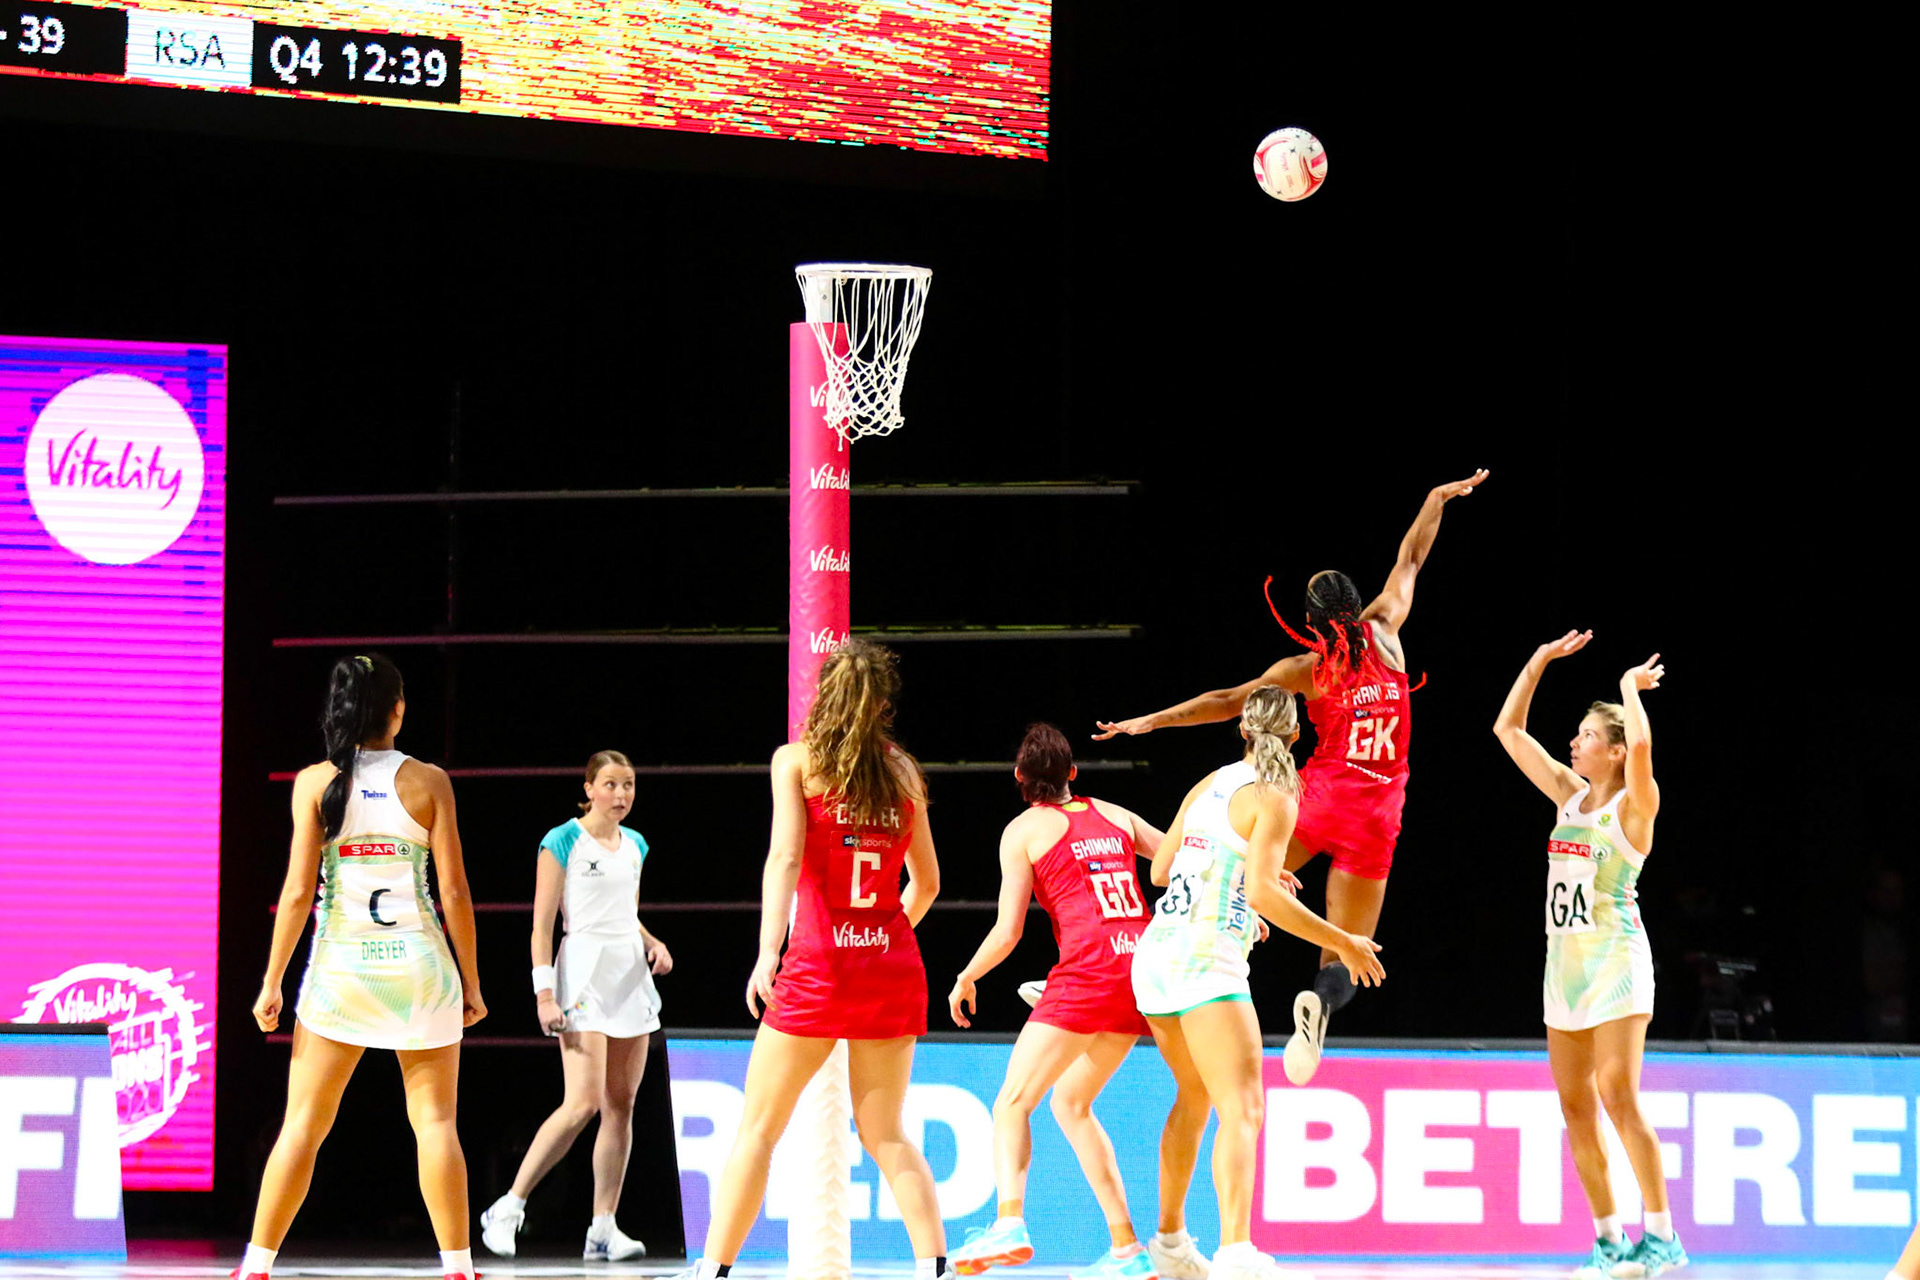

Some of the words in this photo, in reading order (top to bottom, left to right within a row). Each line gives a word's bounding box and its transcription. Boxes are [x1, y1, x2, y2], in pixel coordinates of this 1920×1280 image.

[17, 14, 66, 55] 39
[154, 26, 226, 71] RSA
[269, 35, 324, 85] Q4
[340, 41, 448, 89] 12:39
[47, 427, 183, 511] Vitality
[1346, 716, 1400, 761] GK
[351, 843, 395, 856] SPAR
[1071, 837, 1125, 860] SHIMMIN
[1550, 841, 1590, 856] SPAR
[850, 851, 881, 908] C
[1090, 870, 1144, 919] GD
[369, 888, 397, 927] C
[1550, 882, 1589, 927] GA
[361, 940, 408, 961] DREYER
[832, 921, 890, 954] Vitality
[1110, 930, 1141, 955] Vital
[53, 980, 138, 1024] Vitality
[1262, 1087, 1920, 1226] BETFRE
